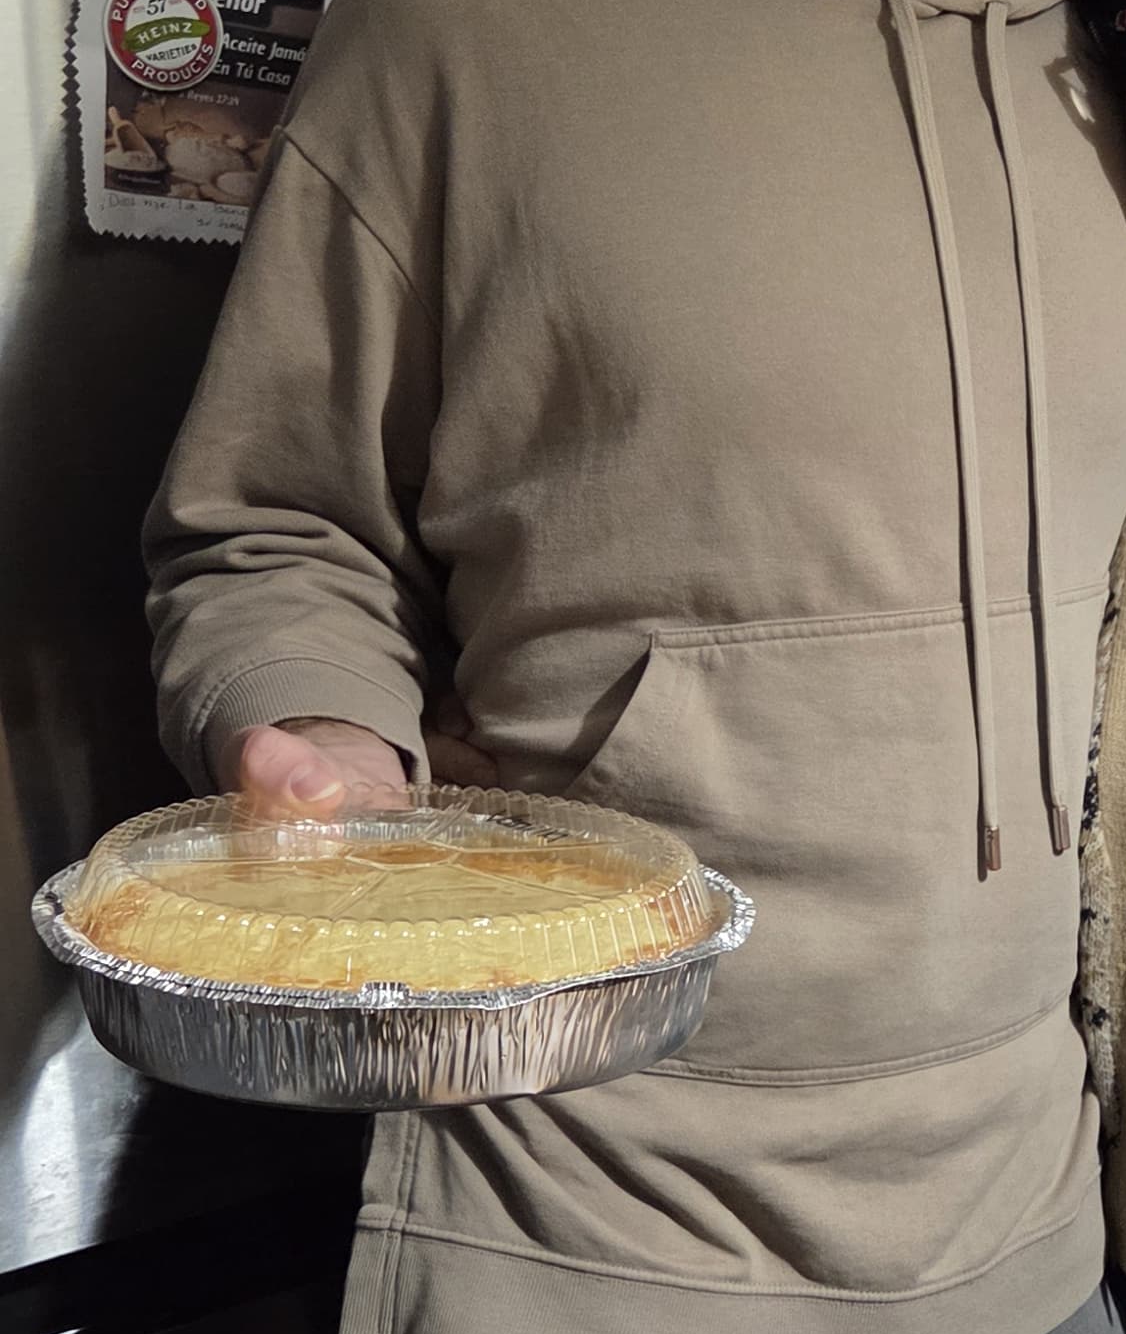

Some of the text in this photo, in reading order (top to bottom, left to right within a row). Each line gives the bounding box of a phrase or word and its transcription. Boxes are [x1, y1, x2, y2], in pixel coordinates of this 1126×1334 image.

[136, 22, 193, 44] HEINZ
[146, 43, 198, 63] VARIETIES
[222, 32, 307, 61] Aceite Jamá
[131, 43, 214, 83] PRODUCTS
[236, 62, 254, 79] Tú
[257, 66, 291, 86] Casa
